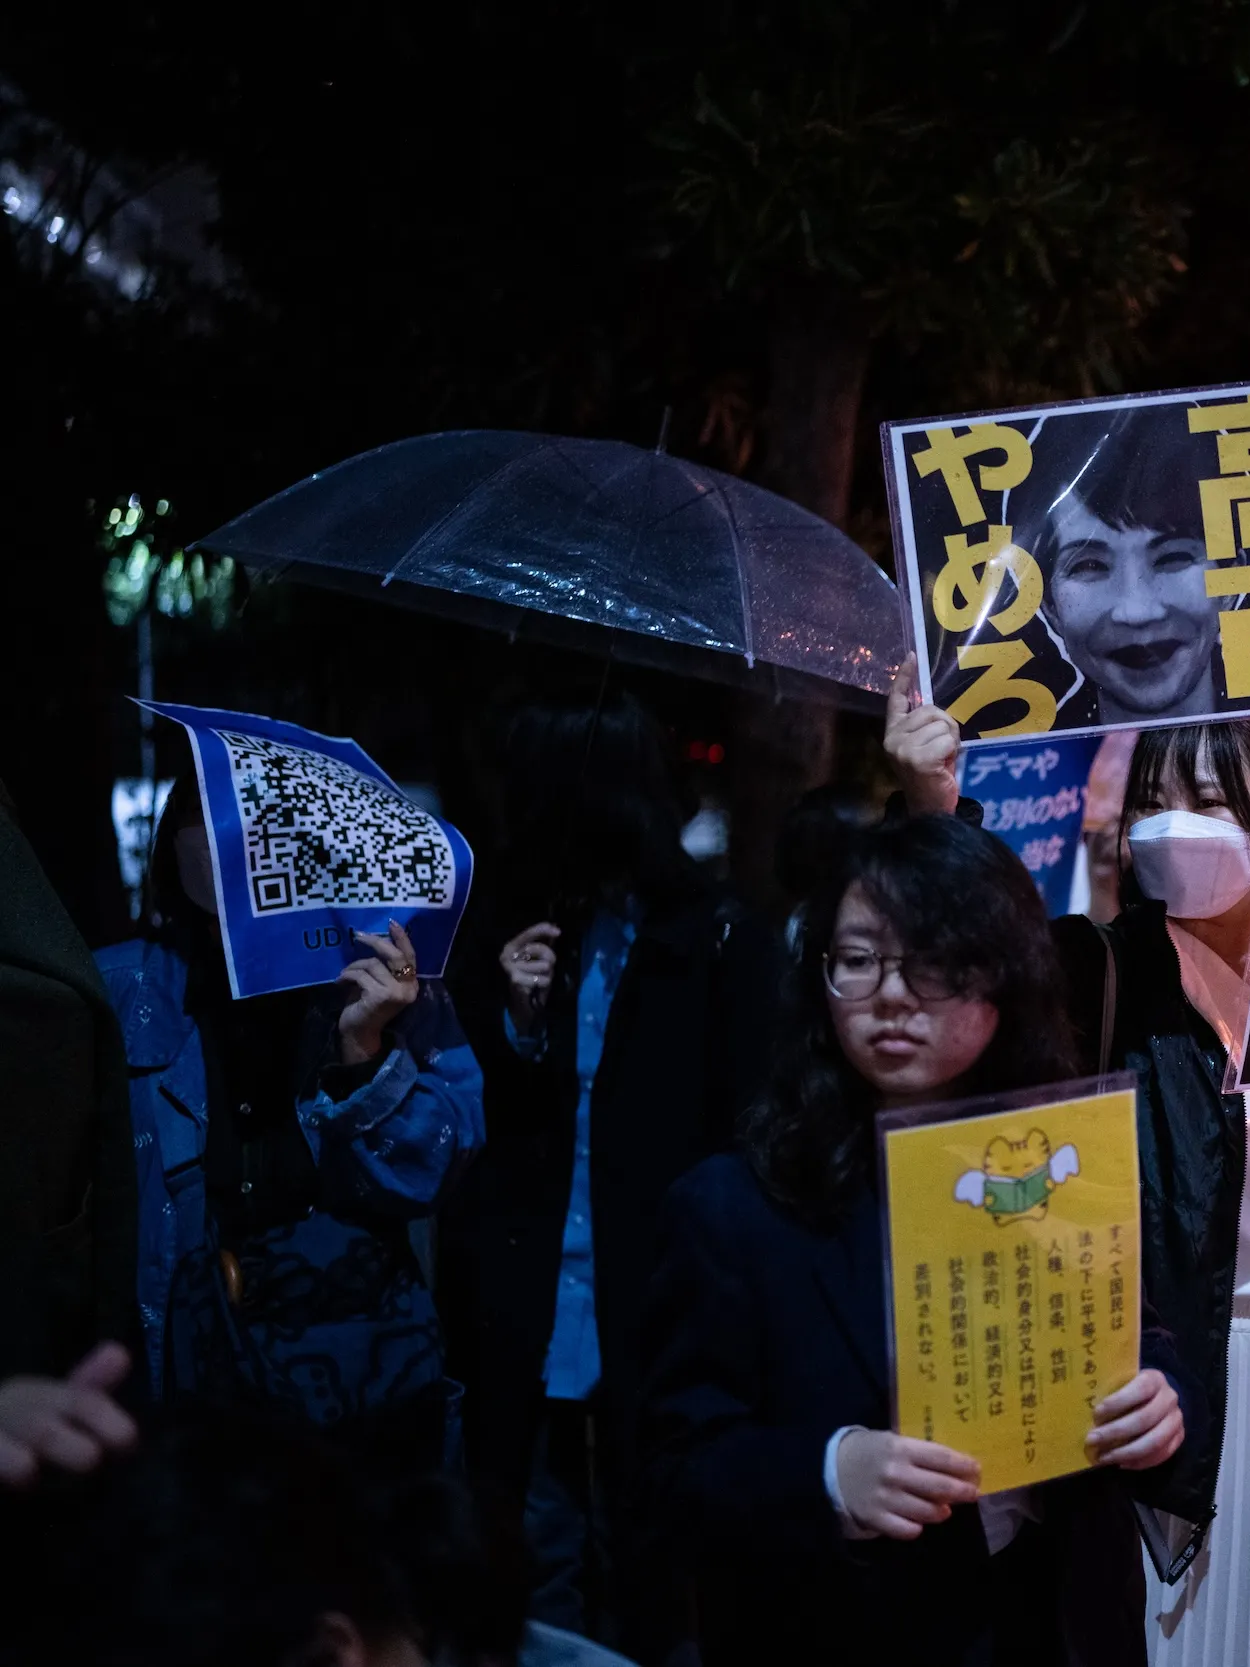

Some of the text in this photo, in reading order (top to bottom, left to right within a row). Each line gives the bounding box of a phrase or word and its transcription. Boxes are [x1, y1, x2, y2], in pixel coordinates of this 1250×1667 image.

[912, 422, 1057, 739] やめろ
[968, 748, 1060, 786] デマや
[1108, 1223, 1125, 1332] すべて国民は
